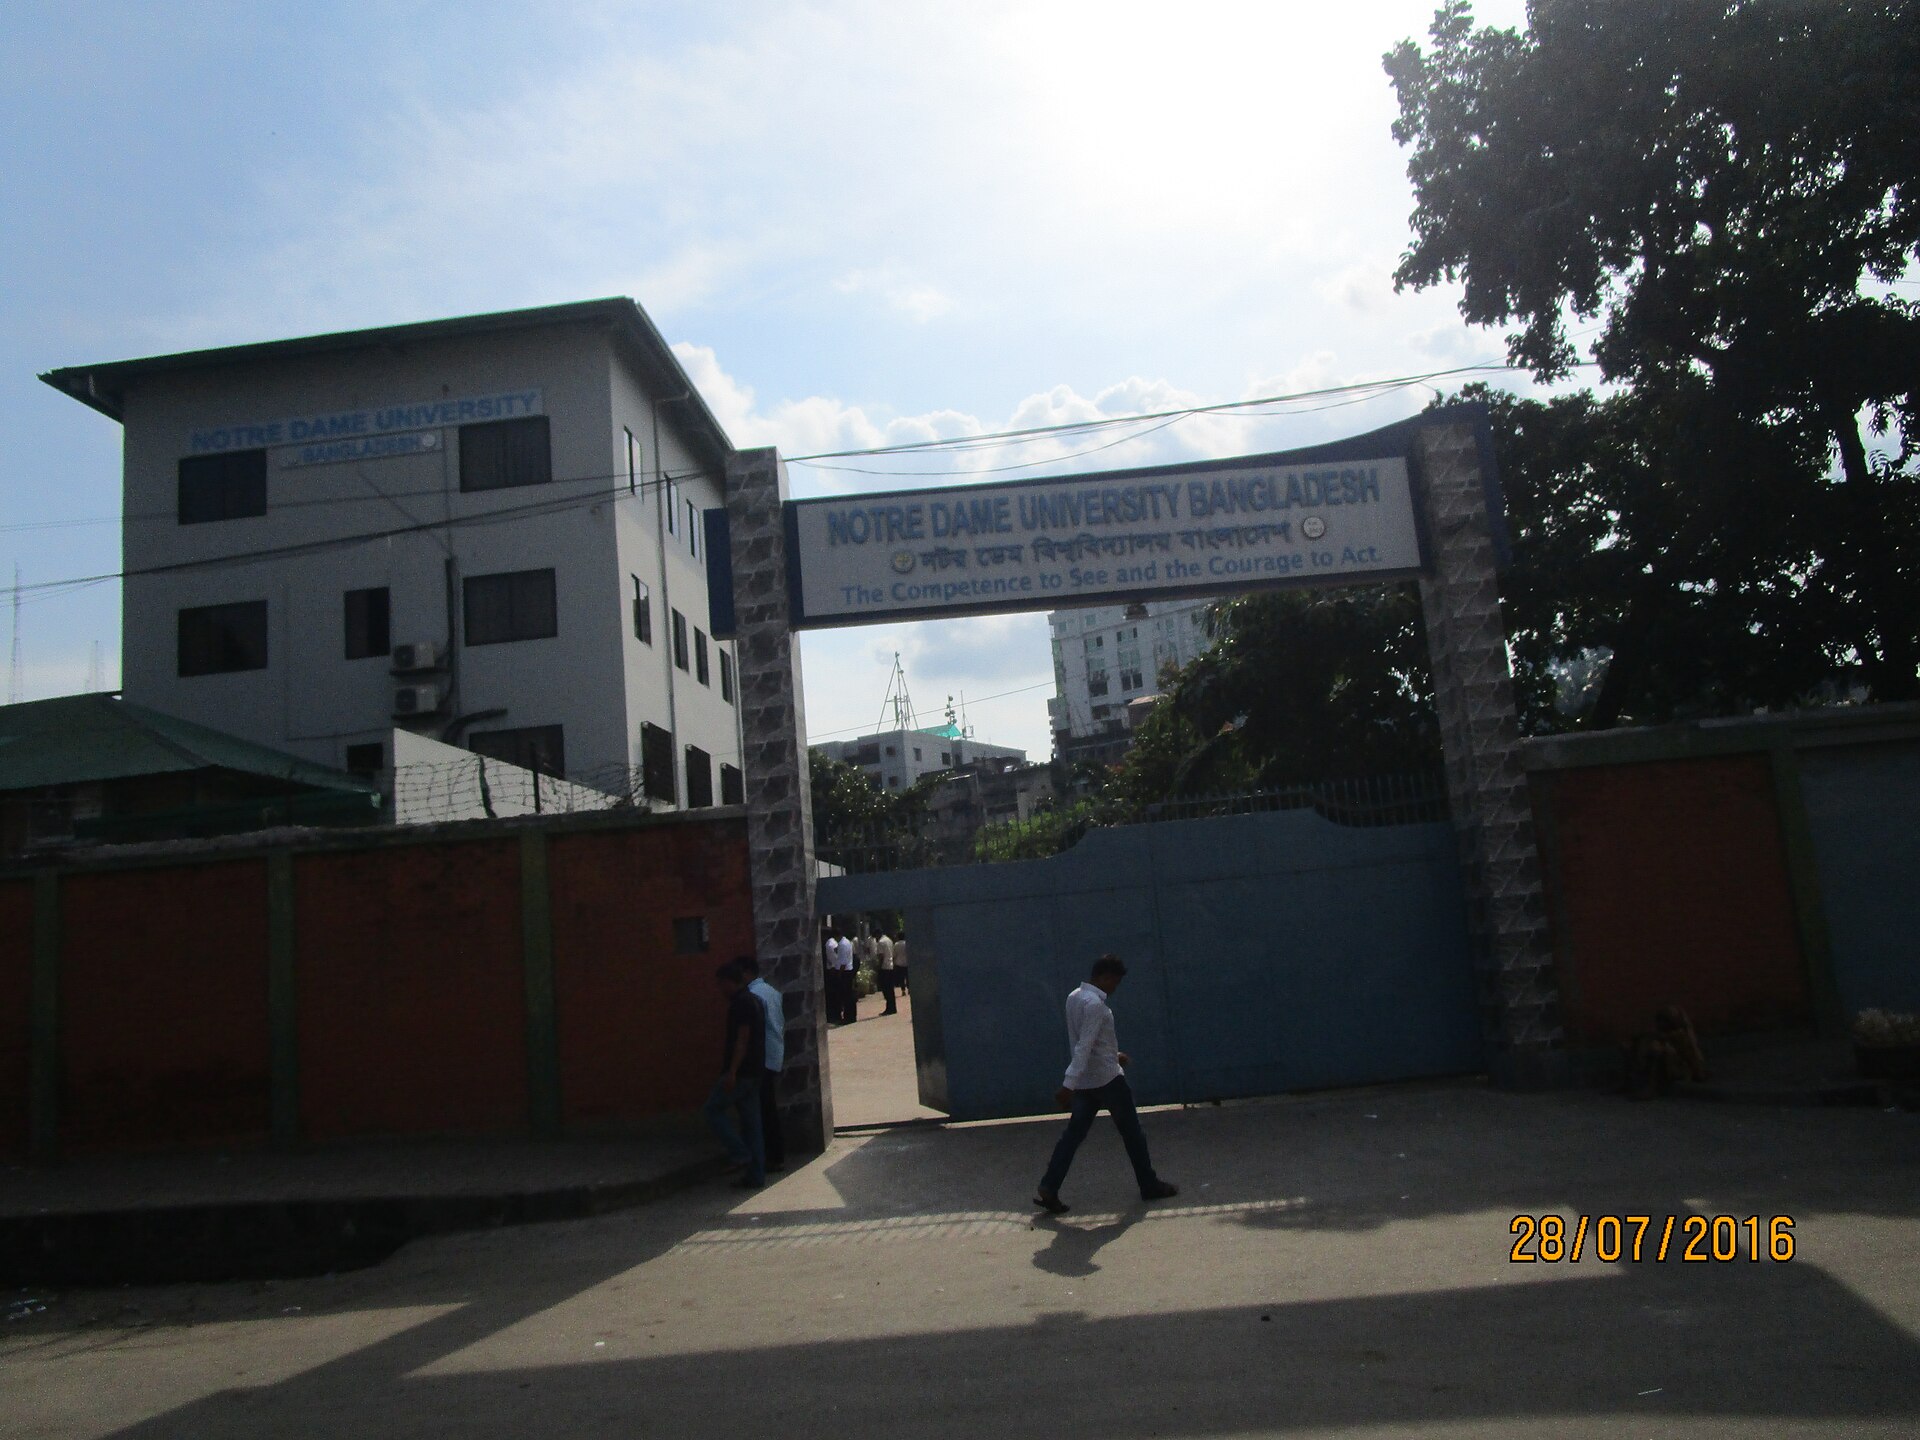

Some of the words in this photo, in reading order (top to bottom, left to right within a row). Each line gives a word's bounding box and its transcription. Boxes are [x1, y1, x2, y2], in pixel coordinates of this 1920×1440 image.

[192, 422, 282, 451] NOTRE
[288, 412, 367, 440] DAME
[374, 391, 537, 430] UNIVERSITY
[827, 504, 924, 546] NOTRE
[931, 496, 1012, 537] DAME
[1019, 482, 1181, 531] UNIVERSITY
[1189, 468, 1380, 517] BANGLADESH
[841, 584, 883, 606] The
[891, 573, 1032, 602] Competence
[1039, 570, 1062, 590] to
[1069, 567, 1108, 588] See
[1116, 560, 1157, 583] and
[1165, 558, 1201, 579] the
[1209, 552, 1302, 574] Courage
[1311, 549, 1333, 567] to
[1340, 544, 1382, 565] Act.
